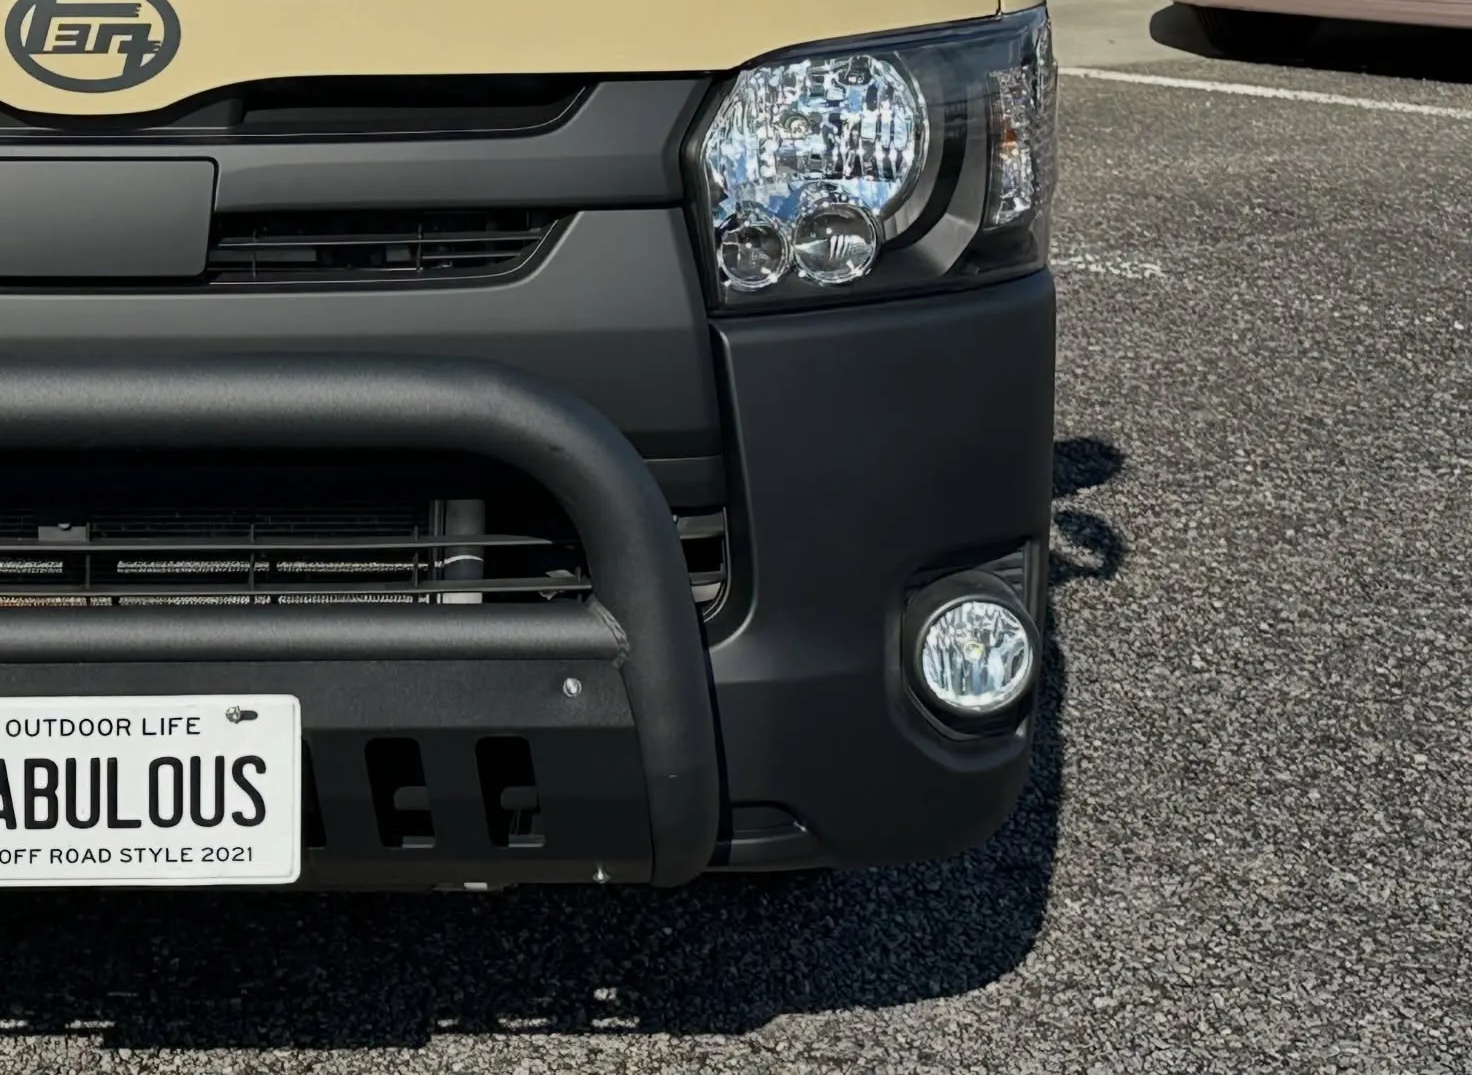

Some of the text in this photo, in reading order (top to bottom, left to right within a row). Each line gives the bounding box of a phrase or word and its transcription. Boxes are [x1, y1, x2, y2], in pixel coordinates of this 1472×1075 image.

[5, 716, 201, 738] OUTDOOR LIFE
[49, 848, 112, 864] ROAD
[119, 847, 194, 863] STYLE
[201, 846, 252, 863] 2021
